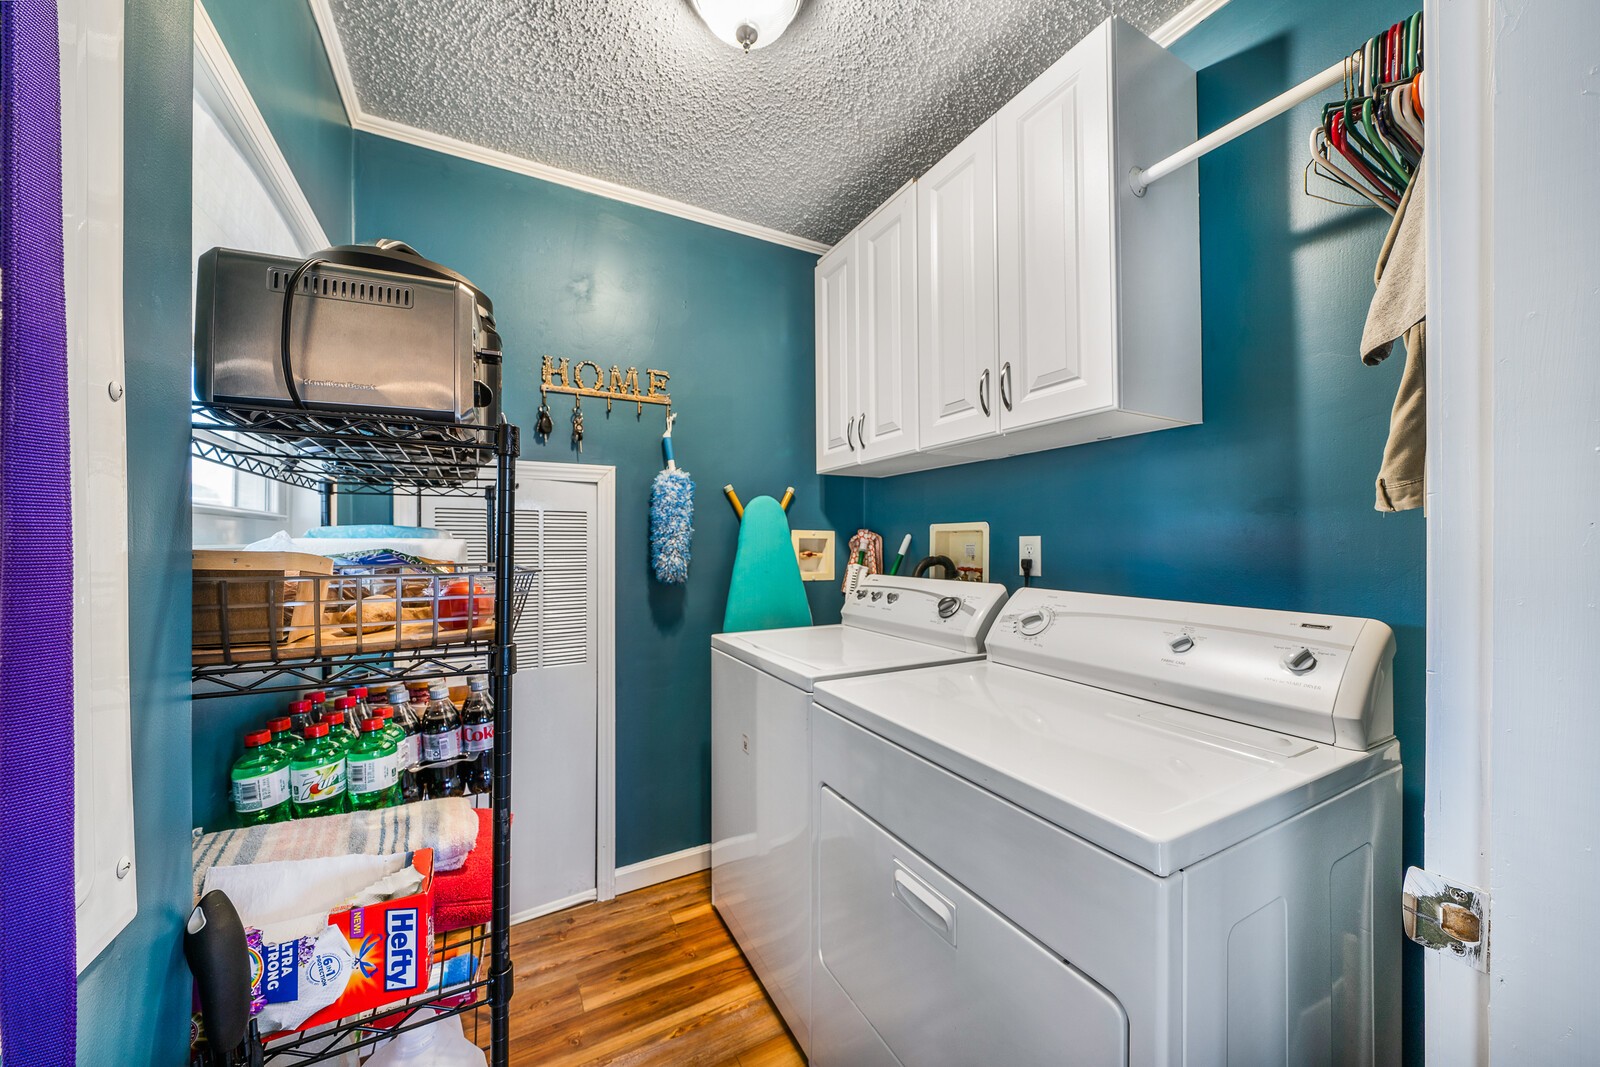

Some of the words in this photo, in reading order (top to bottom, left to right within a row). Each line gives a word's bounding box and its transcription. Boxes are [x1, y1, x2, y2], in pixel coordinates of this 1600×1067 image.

[542, 355, 670, 396] HOME
[353, 911, 362, 934] NEW!
[267, 943, 280, 991] TRONG
[281, 941, 293, 978] LTRA
[387, 913, 414, 985] Hefty
[316, 954, 327, 986] PROTECTION
